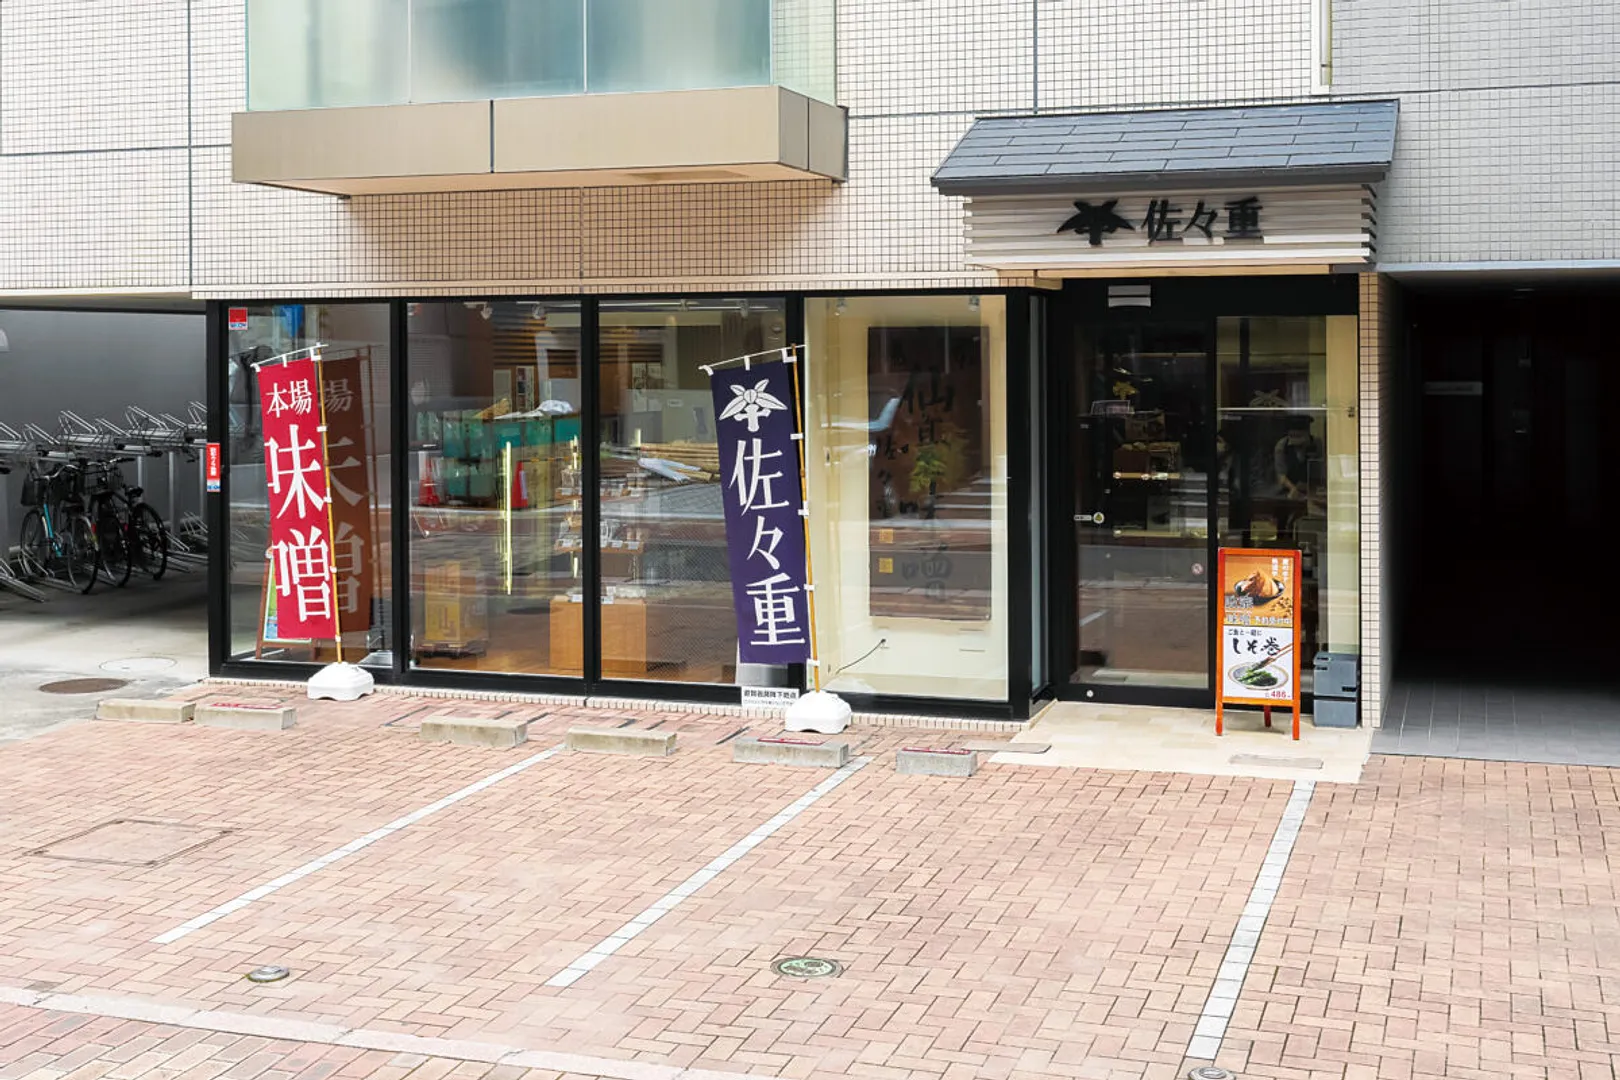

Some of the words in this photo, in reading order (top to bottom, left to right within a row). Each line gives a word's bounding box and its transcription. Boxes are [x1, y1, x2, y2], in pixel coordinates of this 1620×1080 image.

[1141, 196, 1263, 247] 佐々重
[265, 378, 313, 418] 本場
[263, 424, 331, 623] 味噌
[728, 438, 806, 646] 佐々重
[1232, 636, 1281, 656] しそ巻
